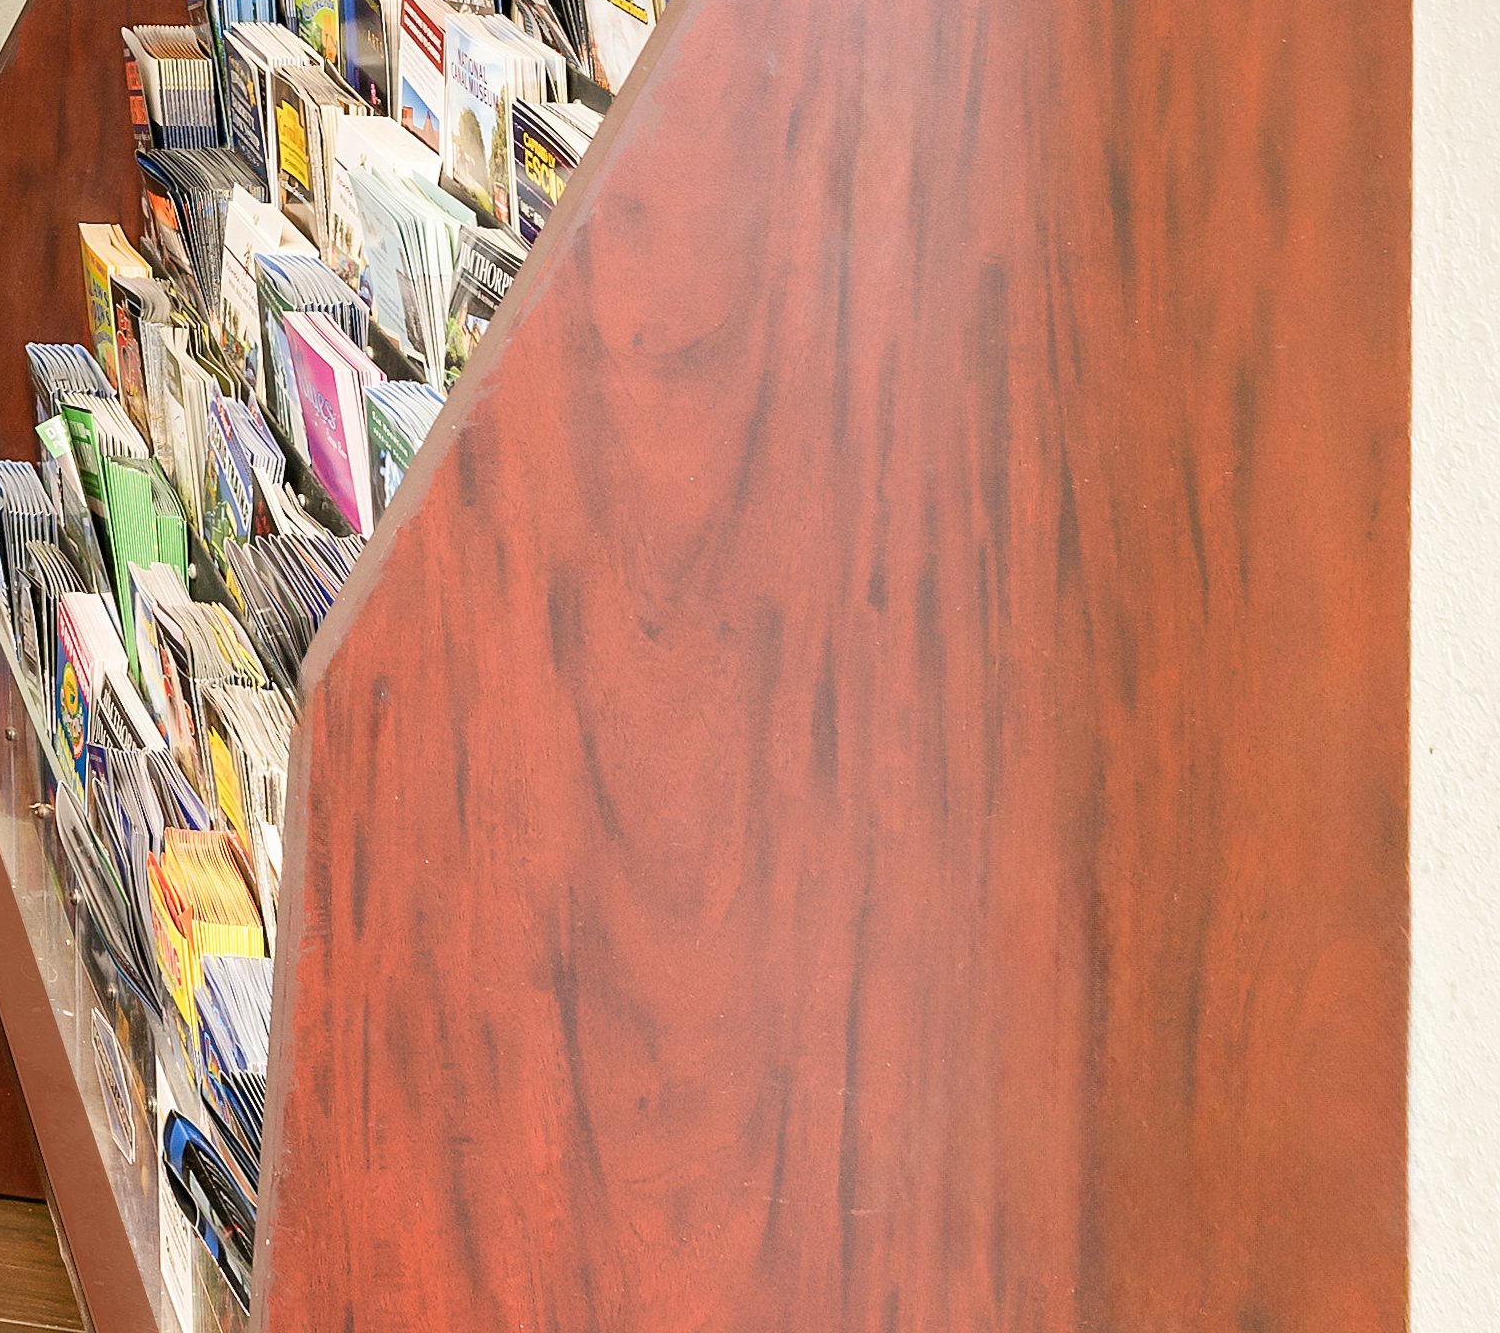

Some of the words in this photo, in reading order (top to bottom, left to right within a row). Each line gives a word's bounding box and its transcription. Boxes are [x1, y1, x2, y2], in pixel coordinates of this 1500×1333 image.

[451, 61, 468, 92] CANAL
[467, 72, 501, 109] MUSEUM
[457, 47, 488, 85] NATIONAL
